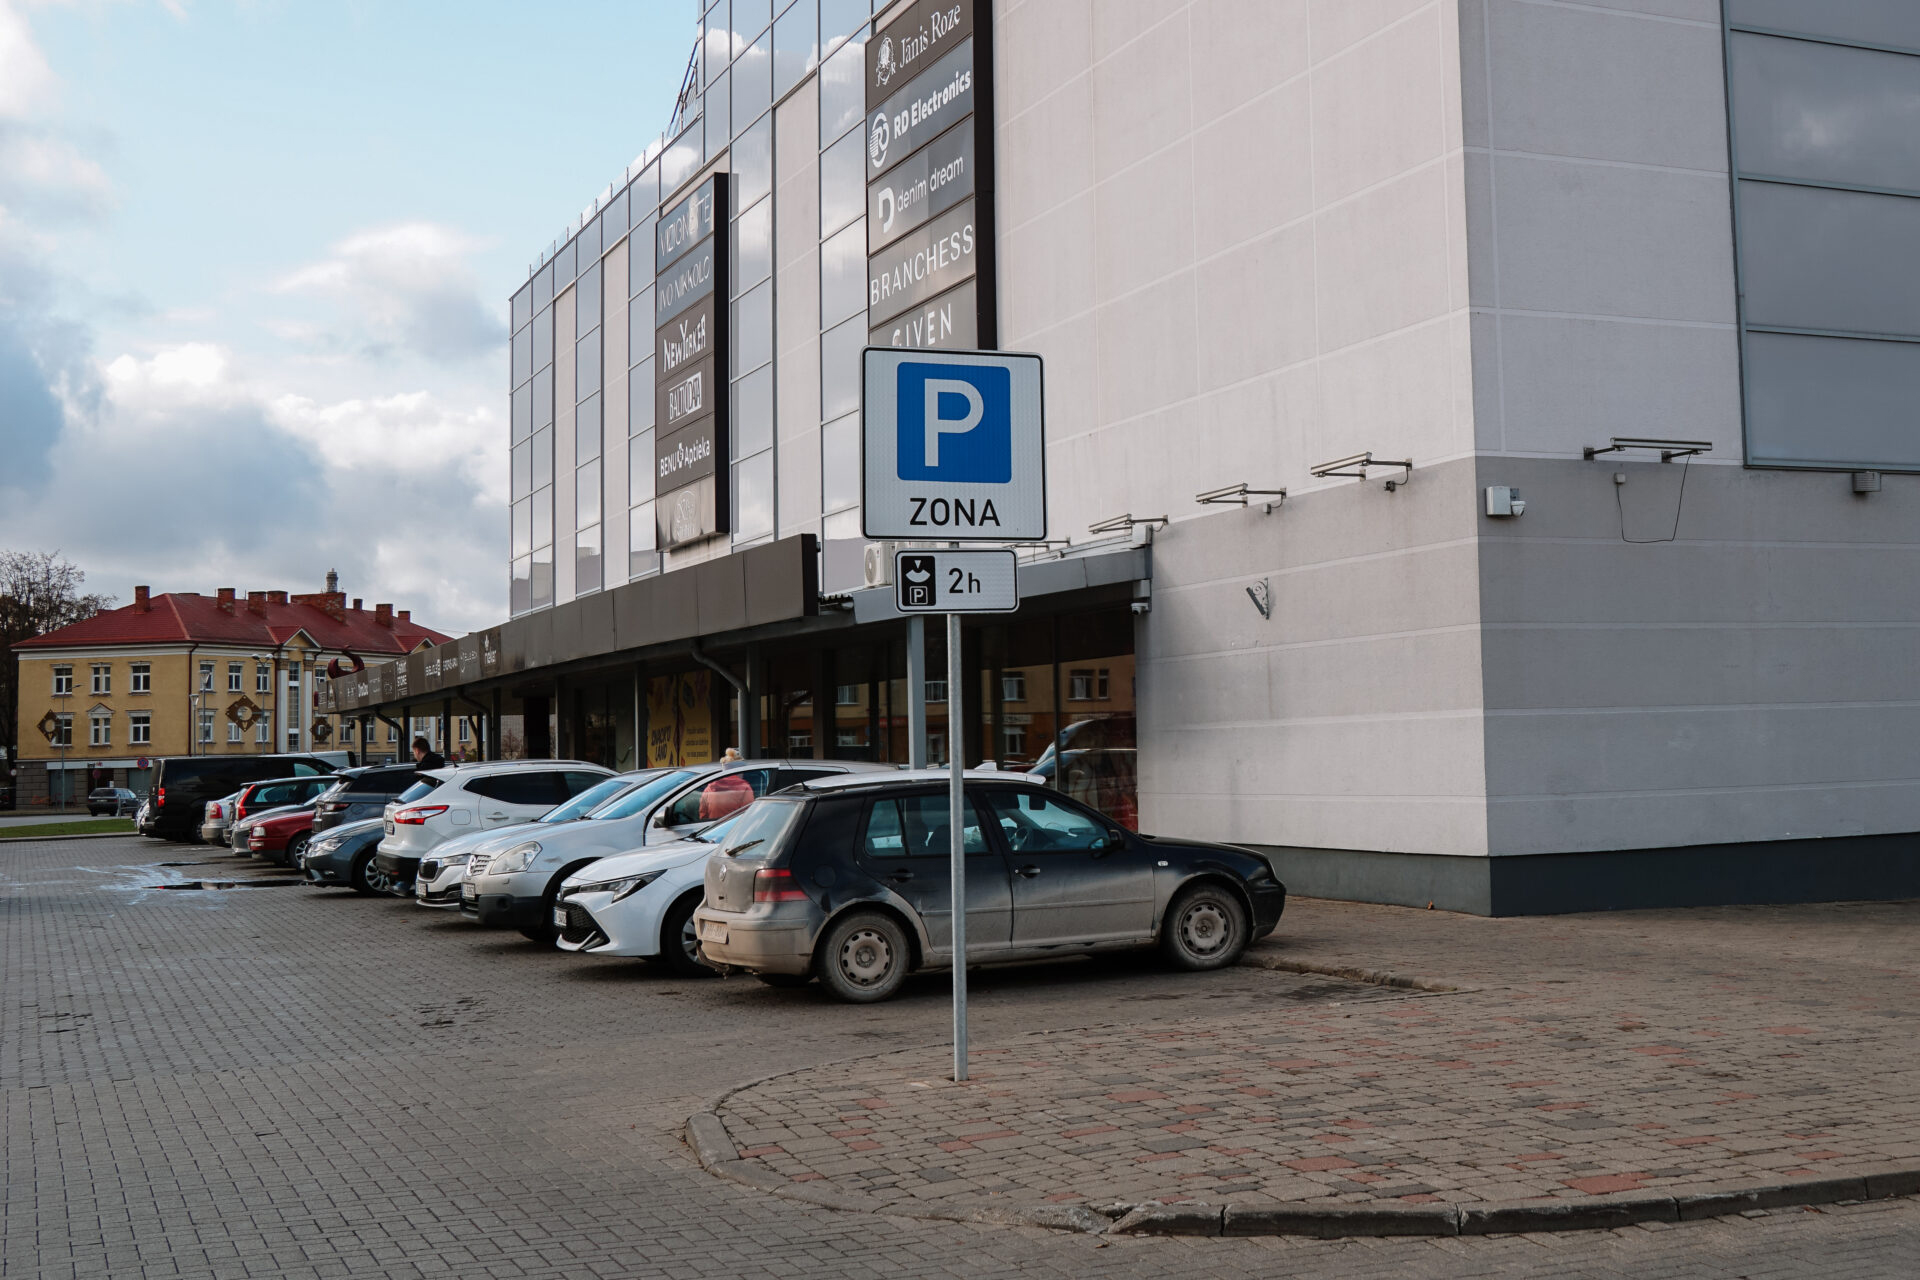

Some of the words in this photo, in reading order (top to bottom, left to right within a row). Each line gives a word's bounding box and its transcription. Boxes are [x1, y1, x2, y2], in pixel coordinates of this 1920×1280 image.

[900, 25, 929, 68] Jānis
[931, 5, 961, 44] Roze
[894, 110, 909, 139] RD
[911, 70, 971, 127] Electronics
[898, 179, 927, 212] denim
[930, 156, 964, 192] dream
[871, 224, 973, 306] BRANCHESS
[924, 378, 984, 467] P
[660, 450, 677, 478] BENU
[684, 436, 710, 469] Aptieka
[909, 498, 1001, 527] ZONA
[914, 589, 924, 603] P
[948, 568, 981, 594] 2h
